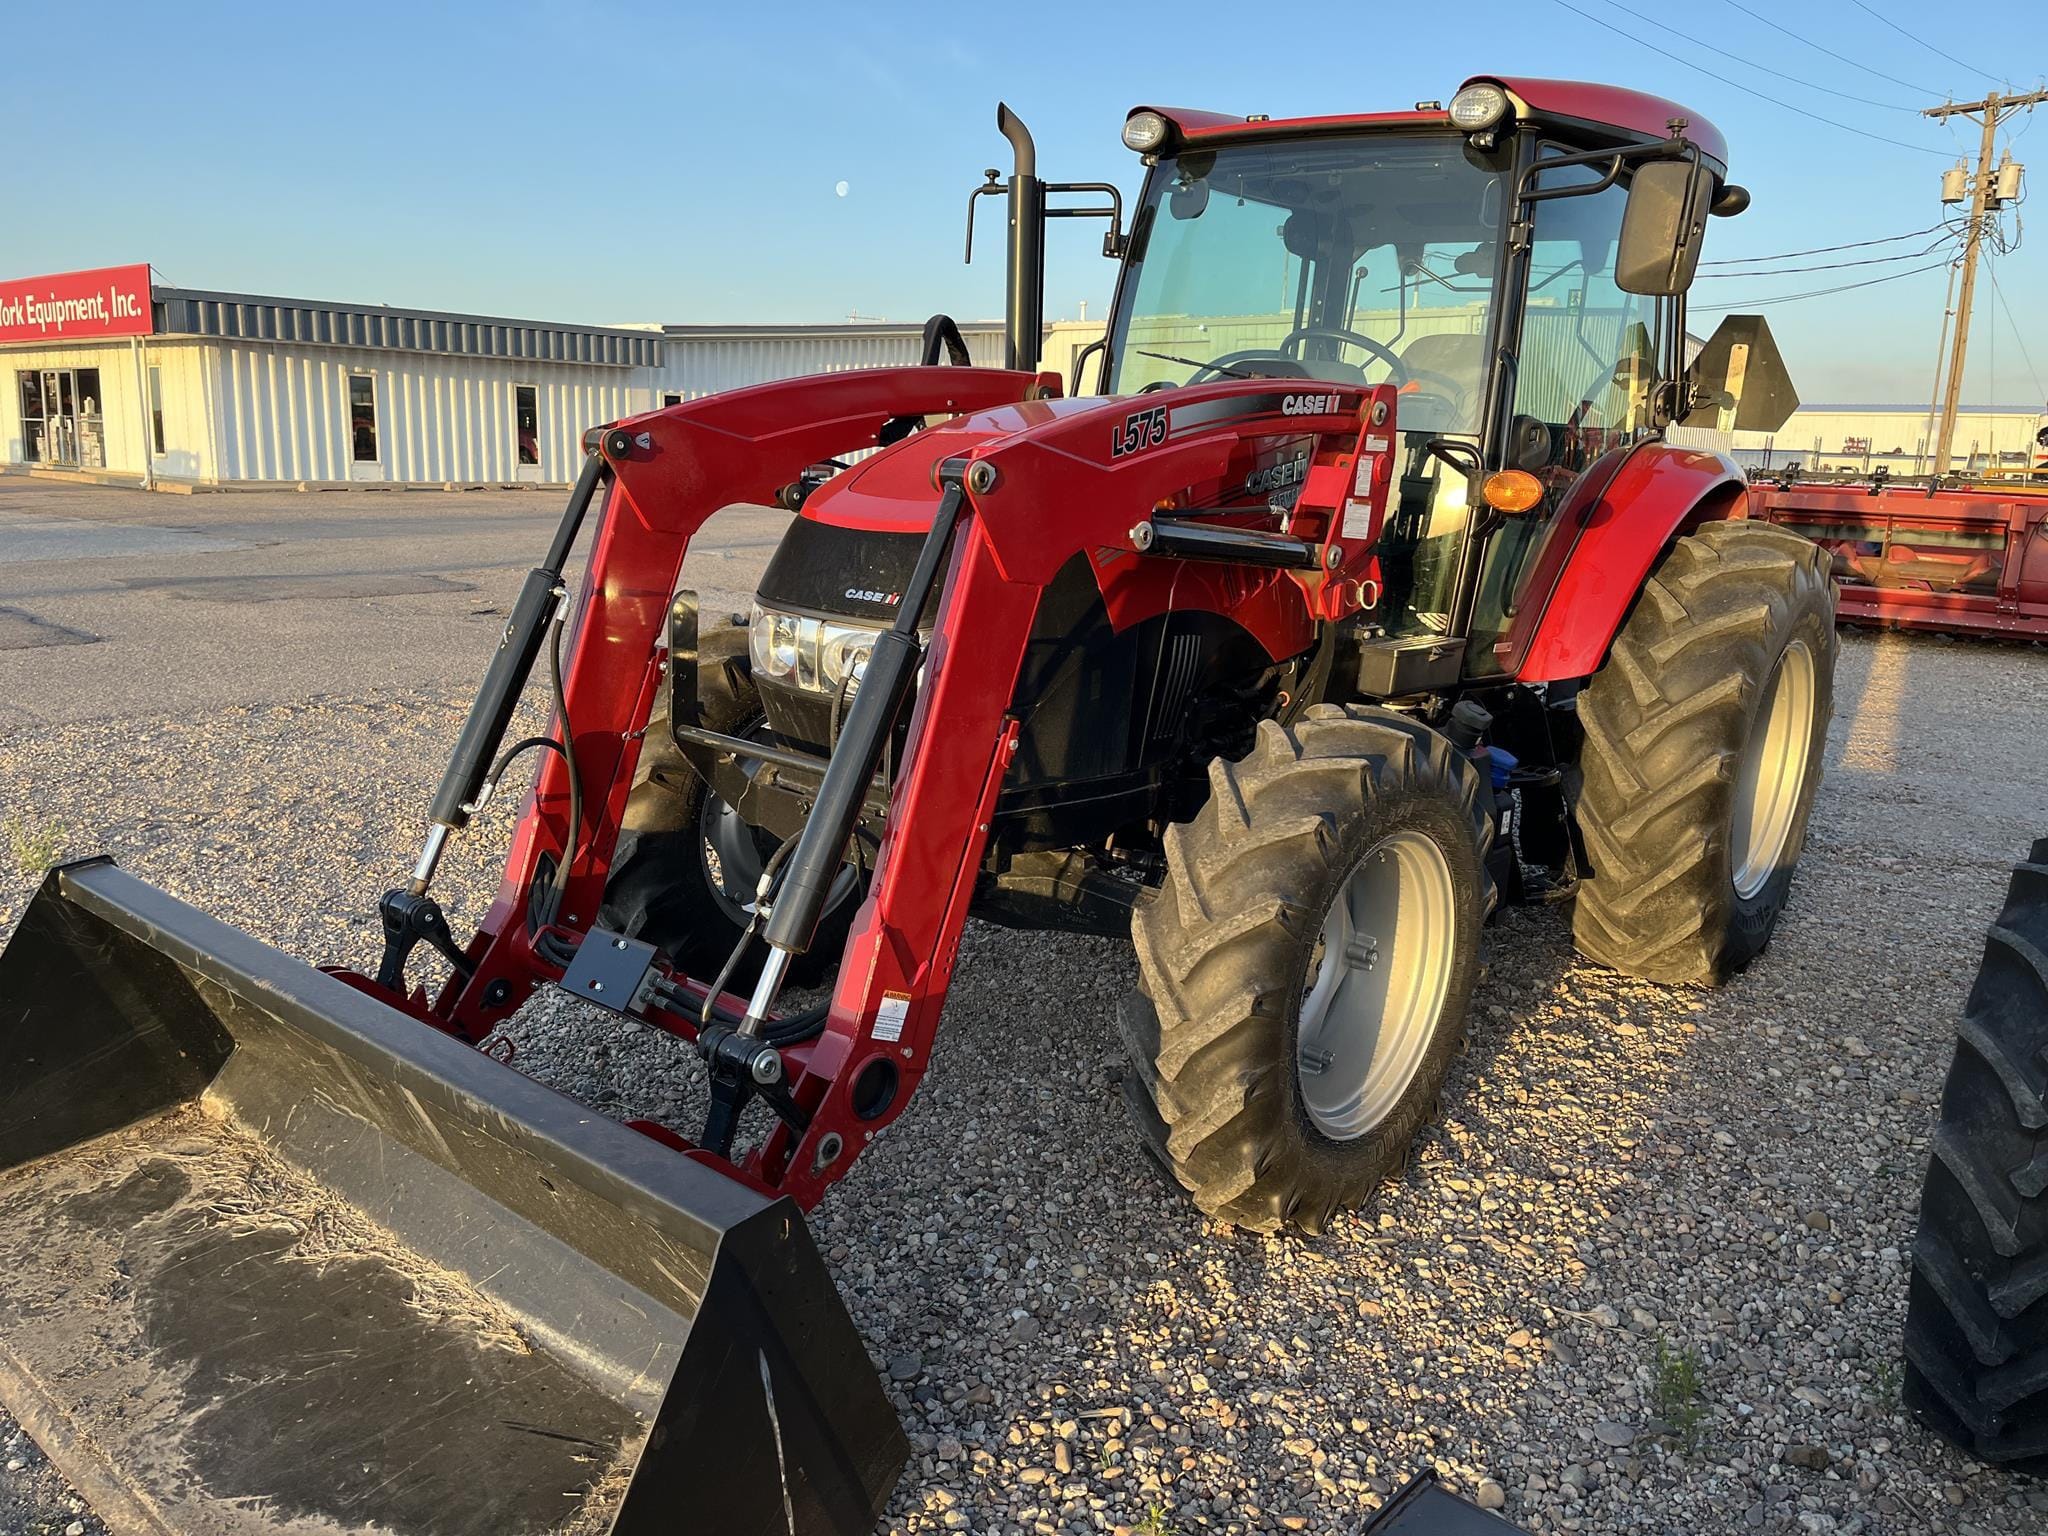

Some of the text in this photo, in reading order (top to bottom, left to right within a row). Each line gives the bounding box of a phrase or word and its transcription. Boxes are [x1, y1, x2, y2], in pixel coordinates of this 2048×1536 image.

[25, 291, 109, 332] Equipment,
[111, 285, 142, 318] Inc.
[1282, 394, 1326, 416] CASE
[1112, 405, 1167, 458] L575
[1246, 462, 1293, 495] CASE
[845, 588, 884, 602] CASE
